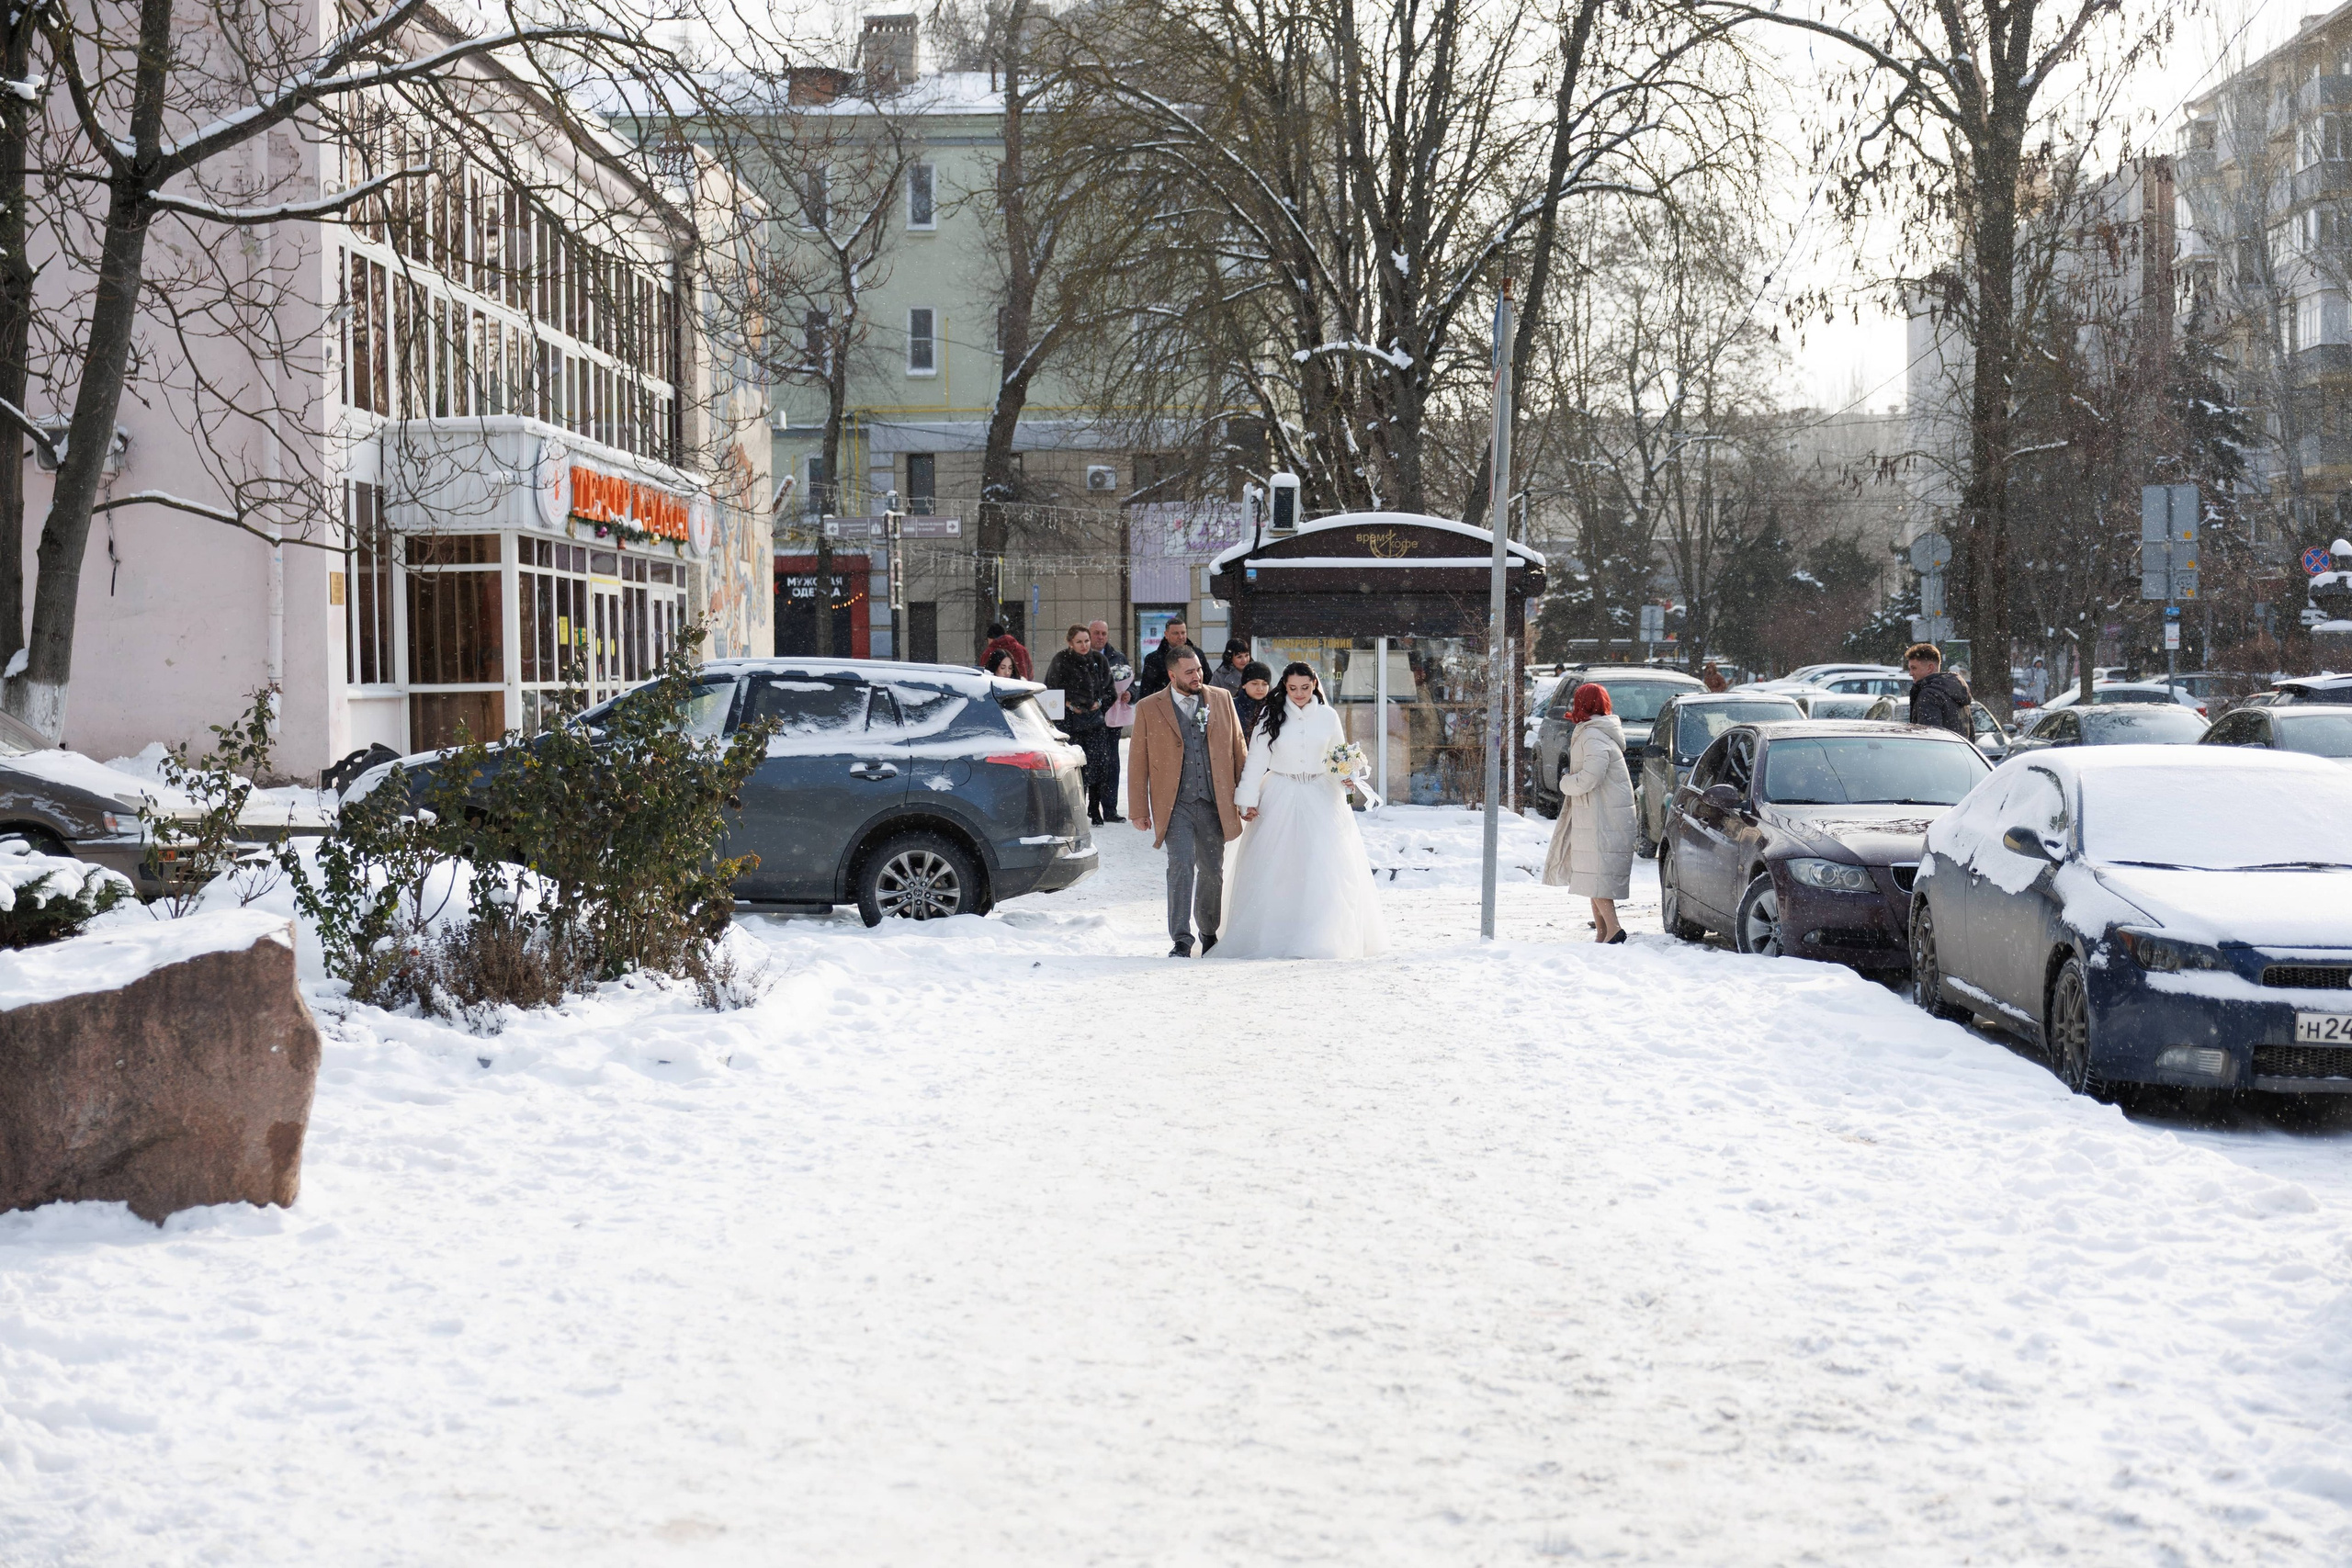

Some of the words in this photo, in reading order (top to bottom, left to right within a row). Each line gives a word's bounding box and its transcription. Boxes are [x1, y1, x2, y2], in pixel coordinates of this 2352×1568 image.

[571, 465, 630, 523] ТЕАТР
[632, 484, 689, 541] КУКОЛ
[1356, 533, 1391, 544] время
[1389, 538, 1418, 548] кофе
[787, 577, 842, 586] МУЖСАЯ
[792, 588, 841, 598] ОДЕА
